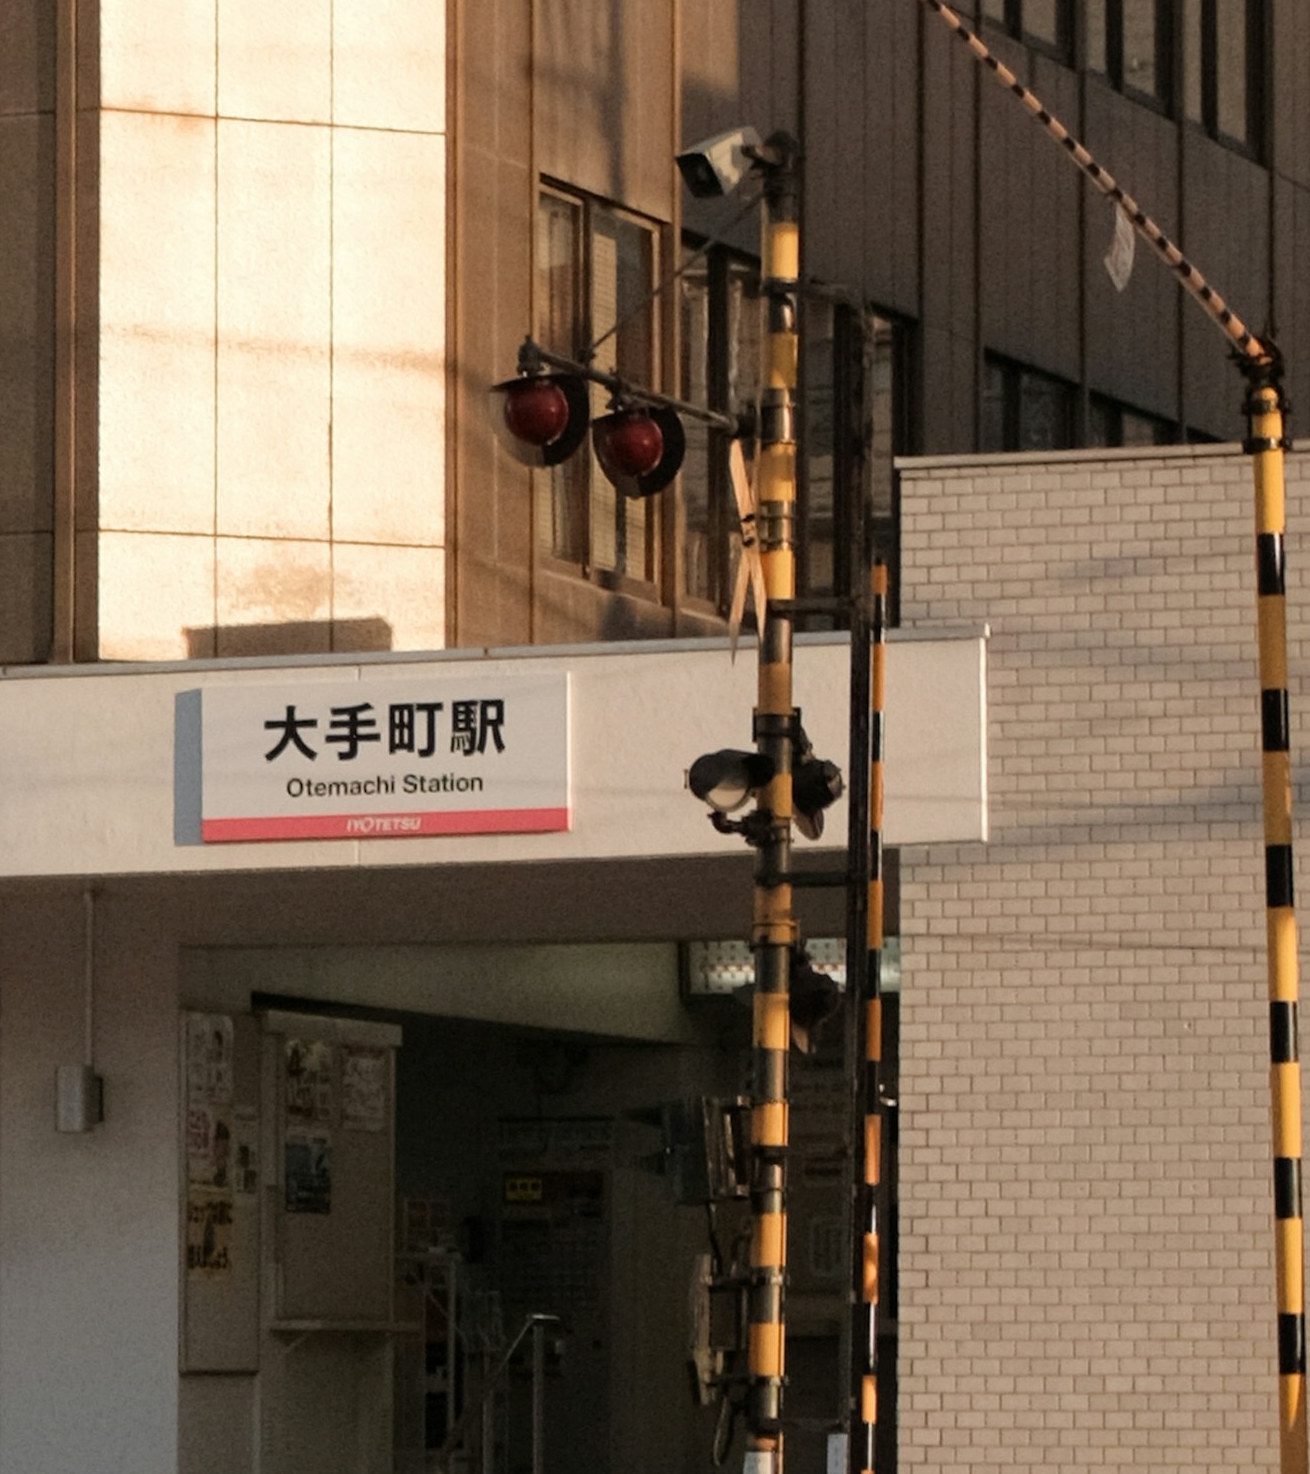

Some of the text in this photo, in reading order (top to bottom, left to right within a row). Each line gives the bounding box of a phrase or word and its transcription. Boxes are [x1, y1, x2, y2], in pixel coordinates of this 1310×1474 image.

[263, 699, 506, 762] 大手町駅
[286, 773, 484, 799] Otemachi Station
[346, 815, 422, 835] IYOTETSU
